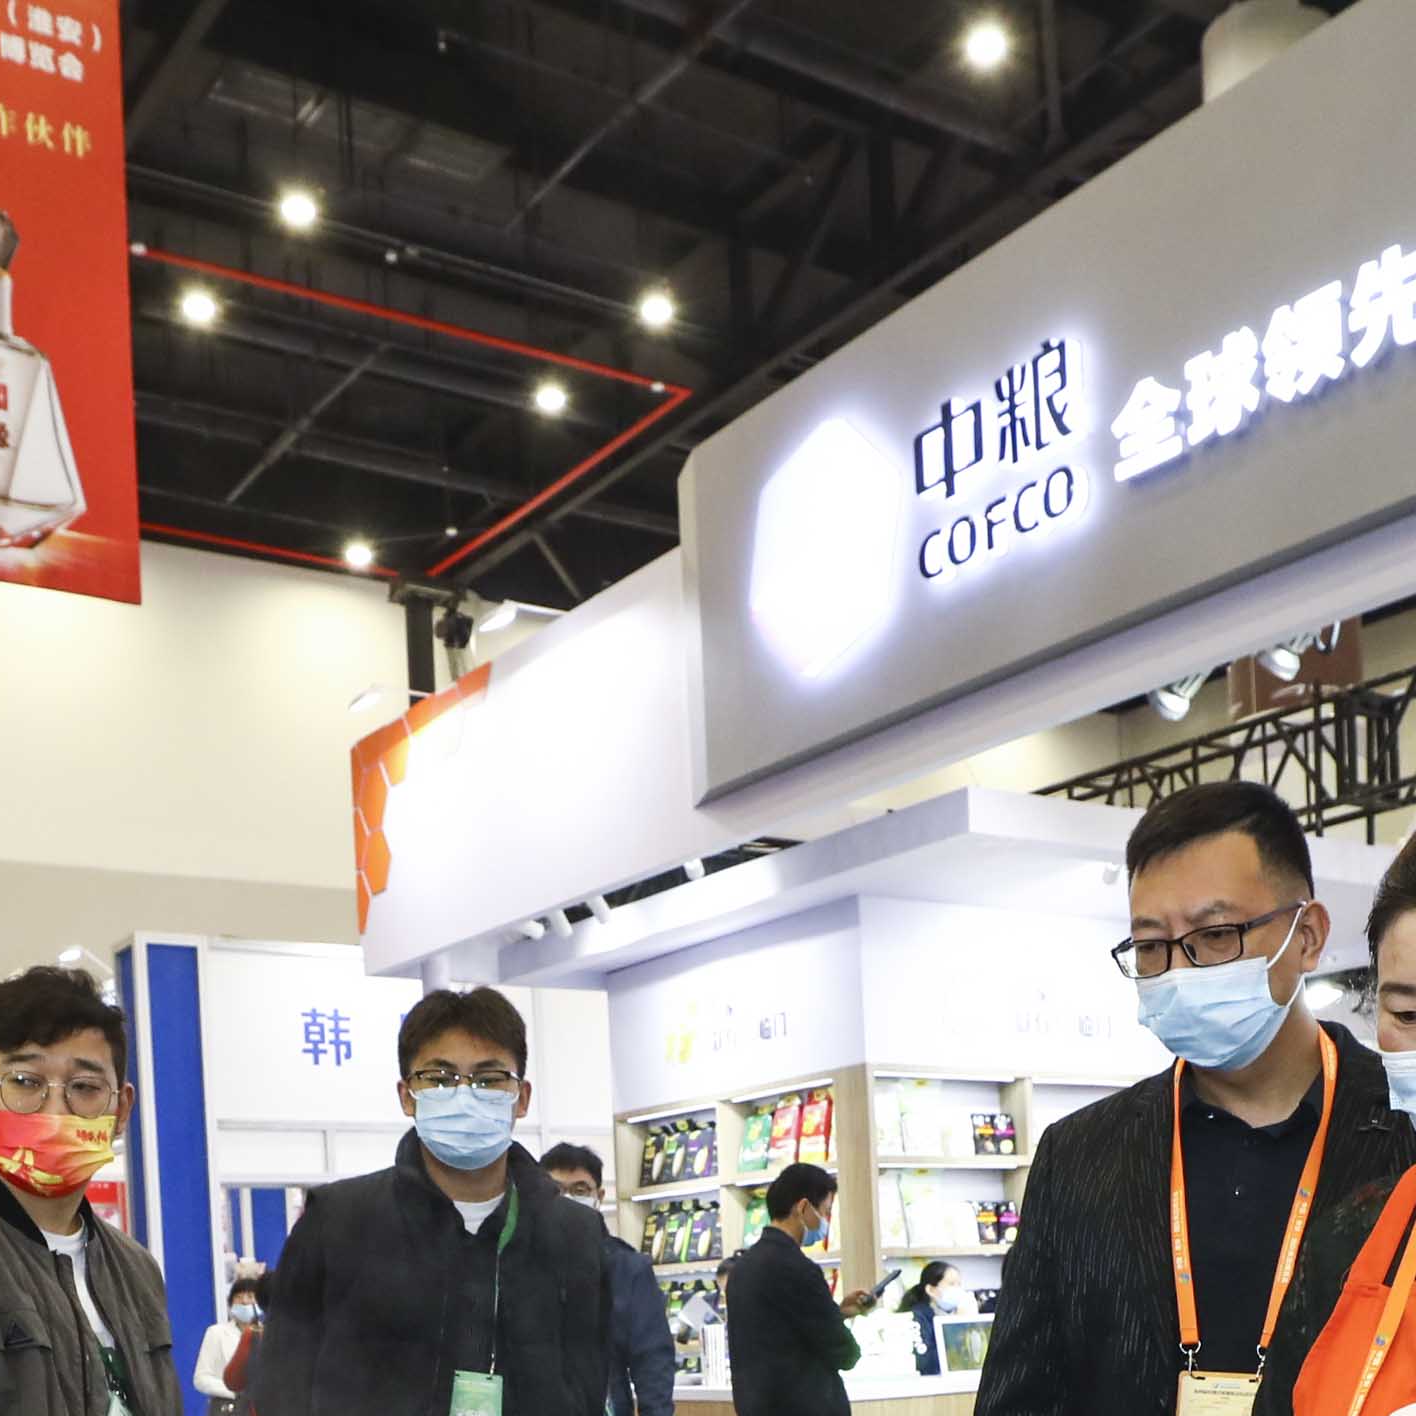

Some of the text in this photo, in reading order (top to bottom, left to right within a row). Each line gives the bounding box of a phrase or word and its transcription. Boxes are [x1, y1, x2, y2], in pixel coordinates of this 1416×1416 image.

[912, 338, 1075, 499] 中粮
[917, 465, 1075, 580] COFCO
[301, 1007, 352, 1067] 韩
